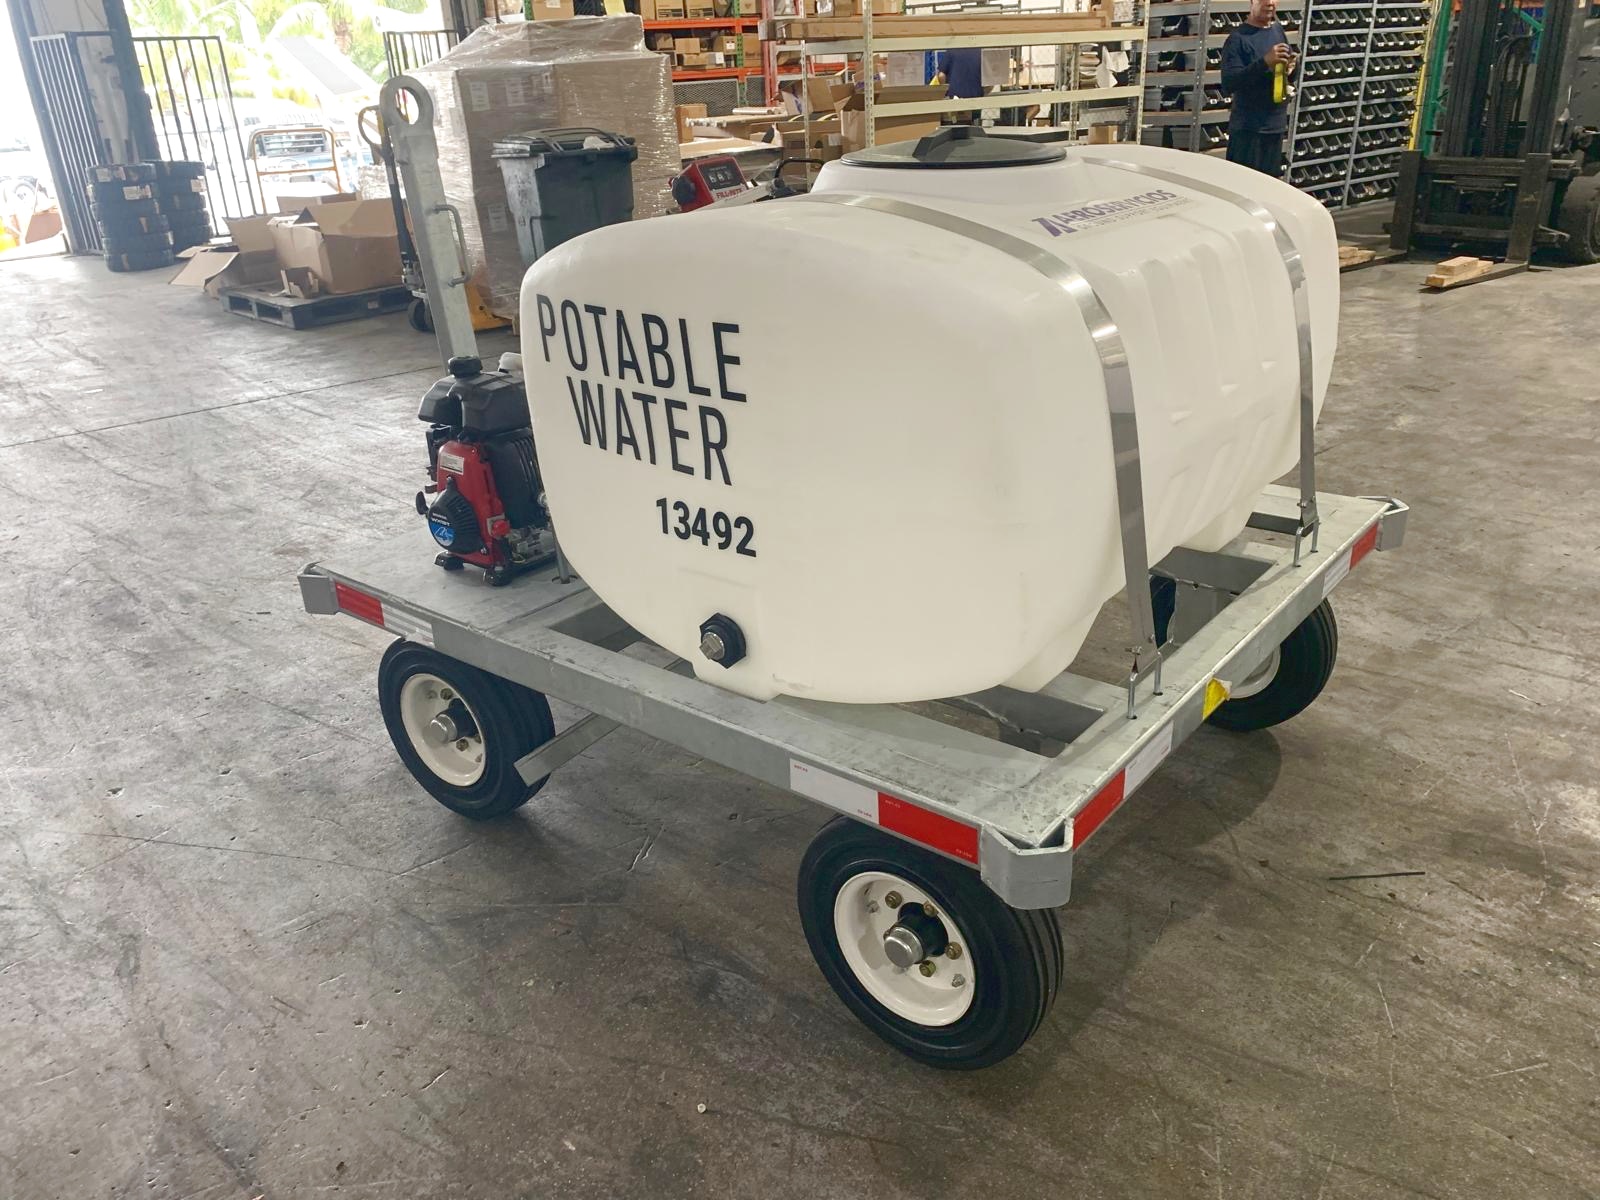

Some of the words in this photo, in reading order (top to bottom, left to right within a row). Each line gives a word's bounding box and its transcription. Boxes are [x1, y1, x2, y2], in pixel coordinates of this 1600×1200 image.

[536, 293, 747, 402] POTABLE
[566, 375, 732, 486] WATER
[656, 497, 757, 557] 13492
